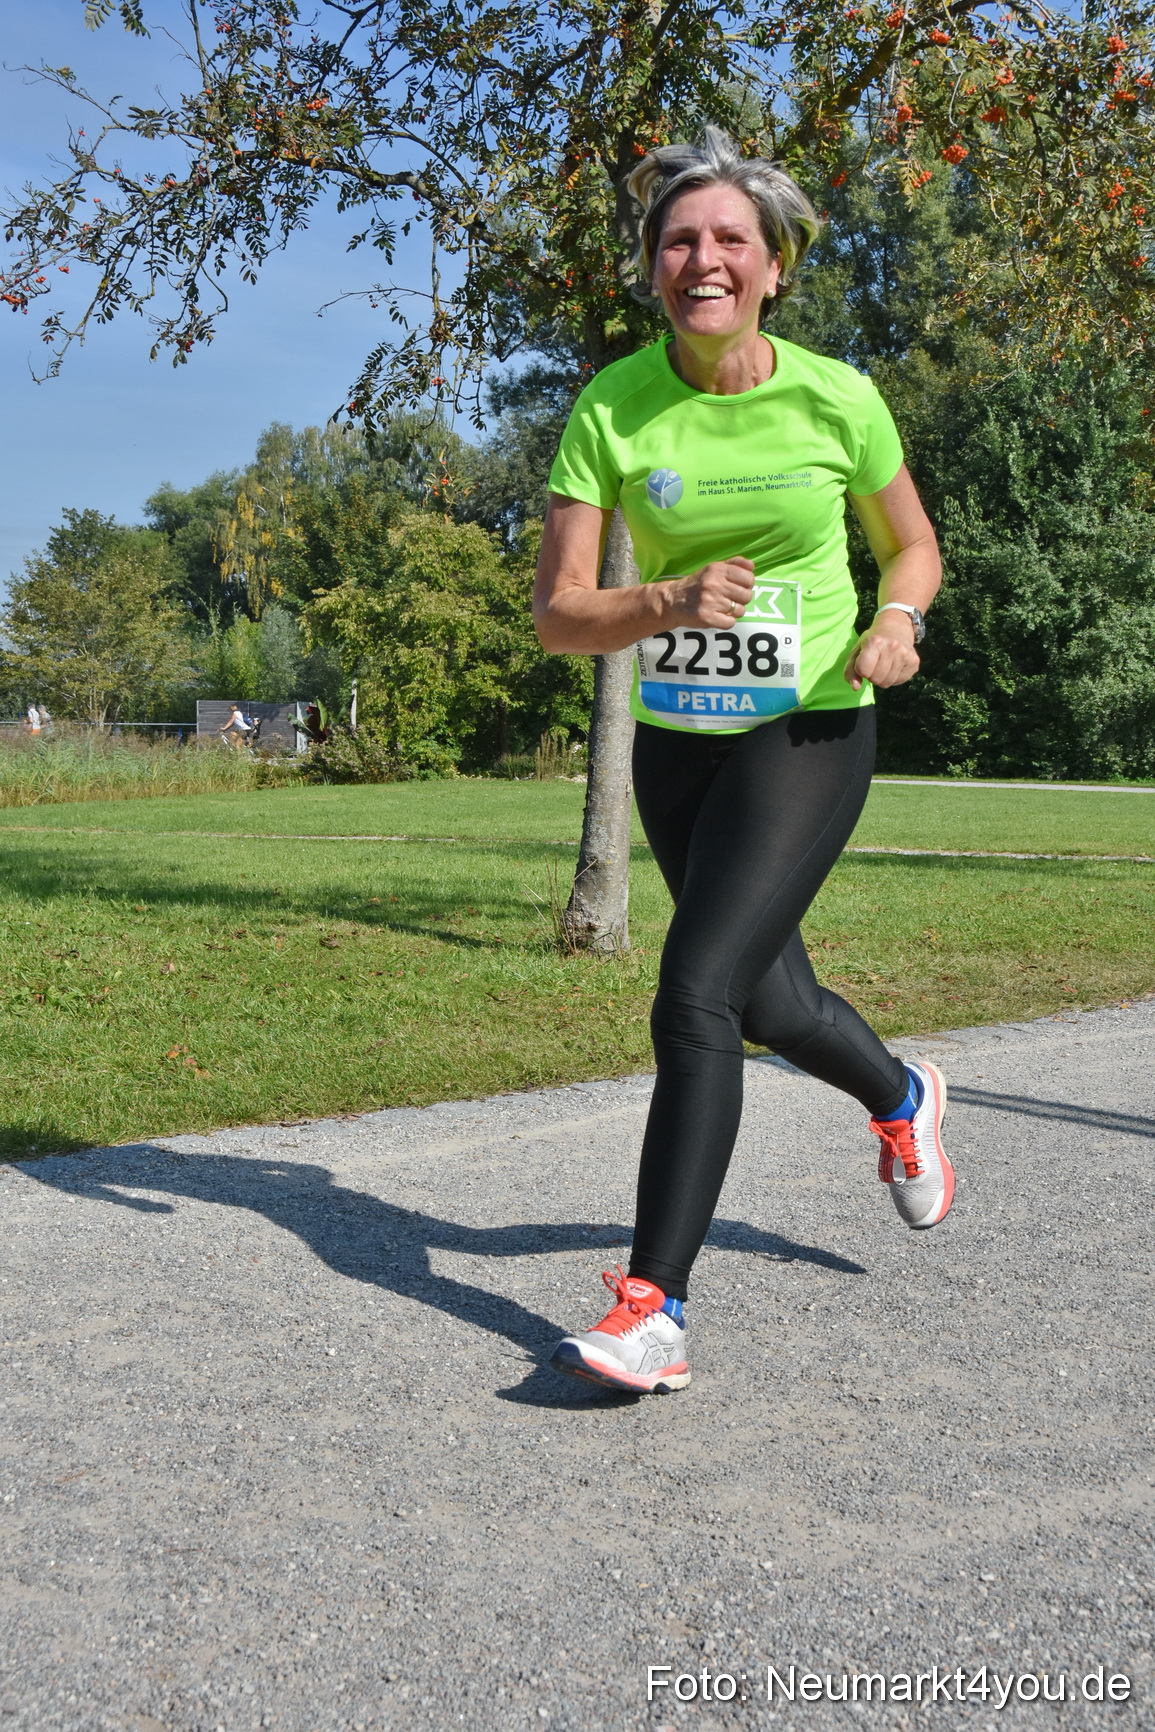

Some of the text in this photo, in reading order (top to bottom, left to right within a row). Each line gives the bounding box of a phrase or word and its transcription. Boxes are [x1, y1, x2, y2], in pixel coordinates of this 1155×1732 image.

[698, 472, 812, 487] Freie katholische Volksschule
[708, 488, 725, 496] Haus
[726, 486, 736, 494] St.
[737, 485, 764, 493] Marien,
[785, 637, 792, 645] D
[653, 631, 779, 678] 2238
[677, 690, 757, 712] PETRA
